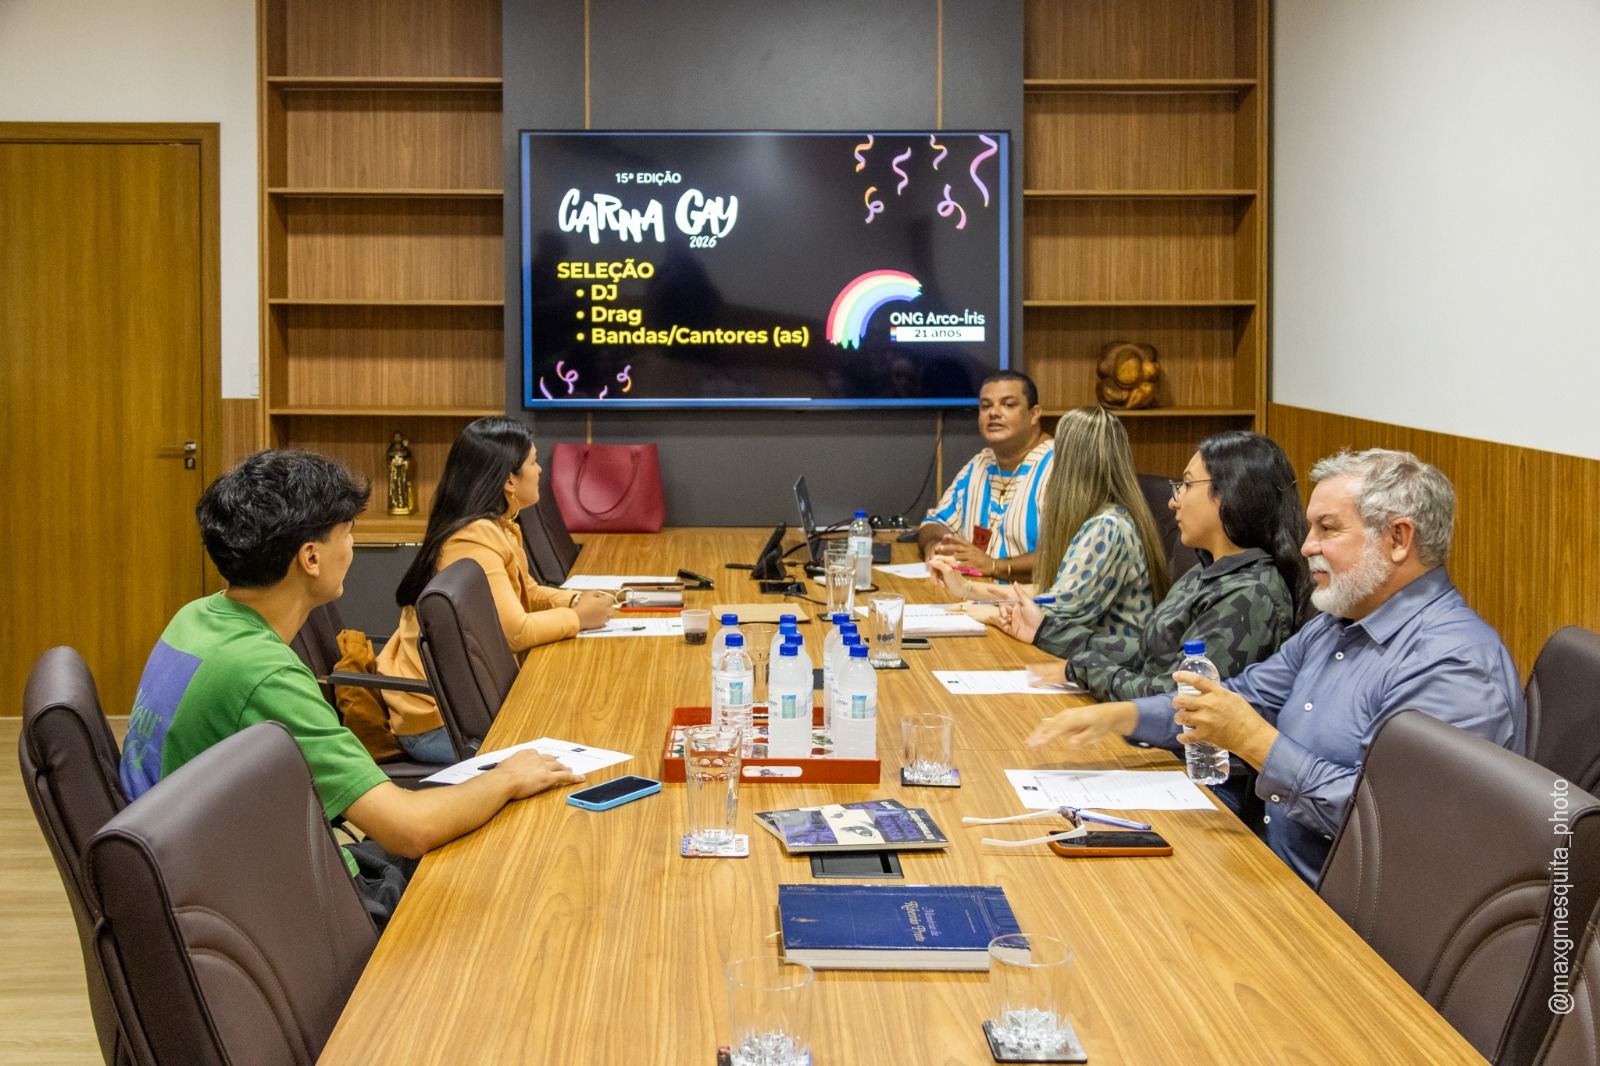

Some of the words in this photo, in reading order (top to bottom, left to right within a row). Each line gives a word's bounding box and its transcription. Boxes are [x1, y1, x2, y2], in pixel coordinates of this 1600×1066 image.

[615, 172, 634, 184] 15ª
[636, 171, 682, 186] EDIÇÃO
[558, 188, 665, 244] CARNA
[675, 188, 738, 238] GAY
[689, 235, 718, 248] 2026
[557, 258, 654, 282] SELEÇÃO
[591, 284, 618, 301] DJ
[591, 306, 642, 326] Drag
[890, 312, 924, 325] ONG
[926, 309, 986, 325] Arco-Íris
[591, 325, 768, 346] Bandas/Cantores
[773, 326, 810, 347] (as)
[914, 328, 928, 338] 21
[931, 328, 962, 338] anos
